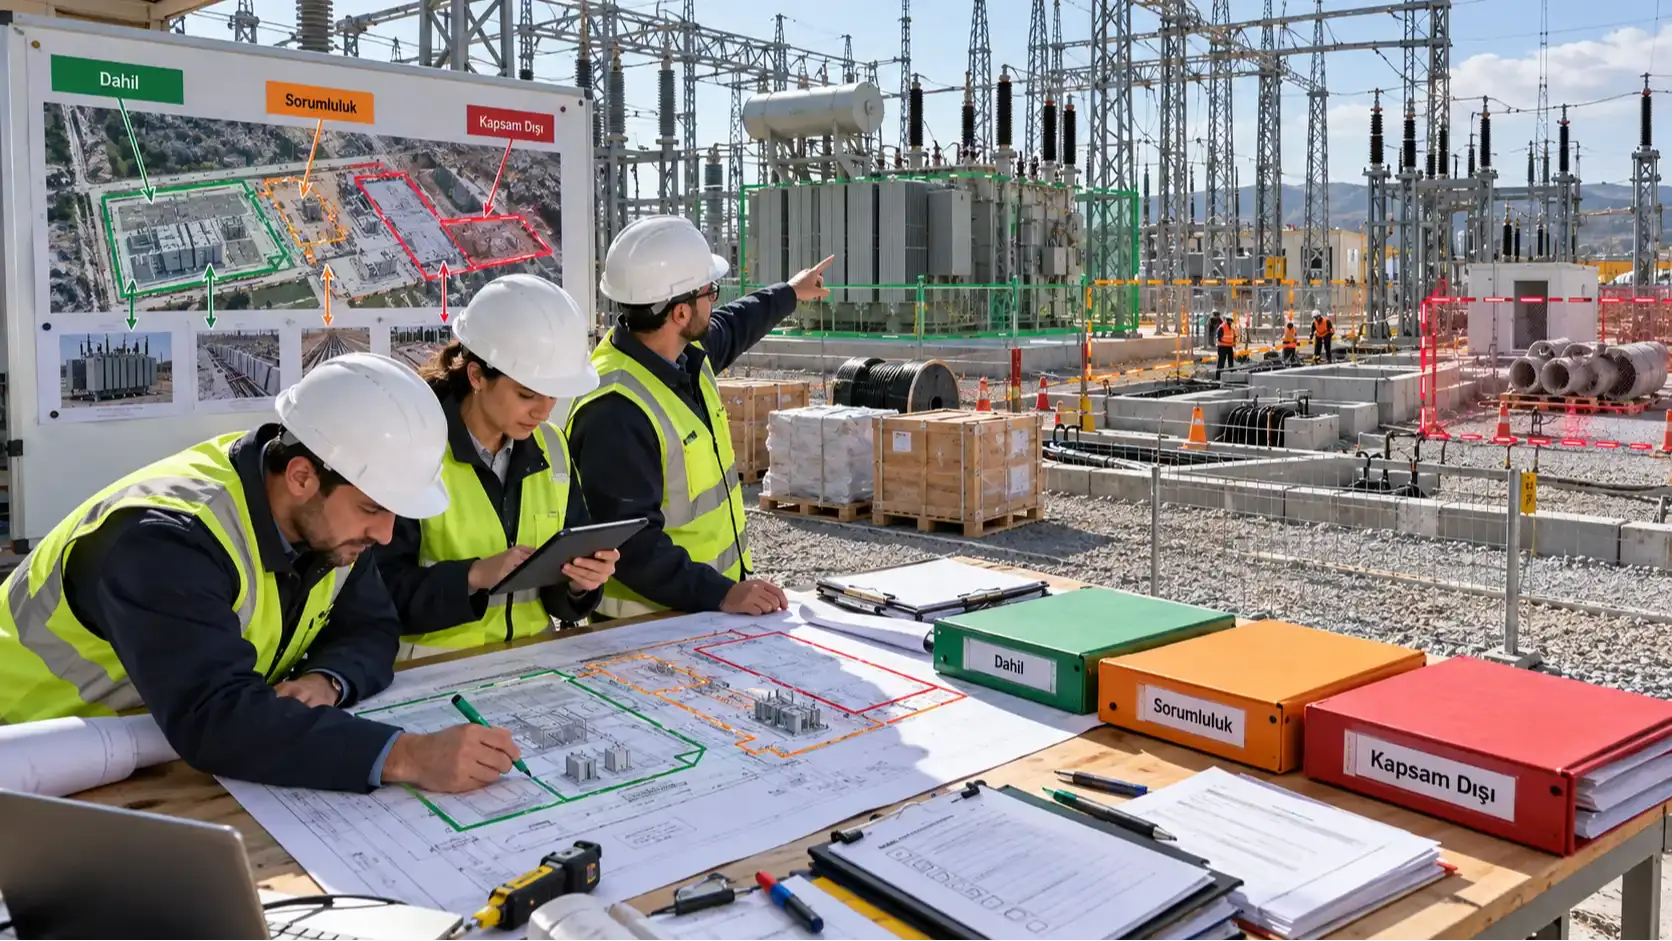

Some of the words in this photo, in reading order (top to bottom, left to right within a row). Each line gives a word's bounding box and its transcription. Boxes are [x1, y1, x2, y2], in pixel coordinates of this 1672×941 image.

[100, 71, 139, 90] Dahil
[285, 93, 357, 114] Sorumluluk
[479, 115, 522, 133] Kapsam
[524, 120, 544, 136] Dışı
[994, 654, 1024, 675] Dahil
[1153, 697, 1233, 734] Sorumluluk
[1370, 749, 1450, 790] Kapsam
[1457, 774, 1496, 805] Dışı
